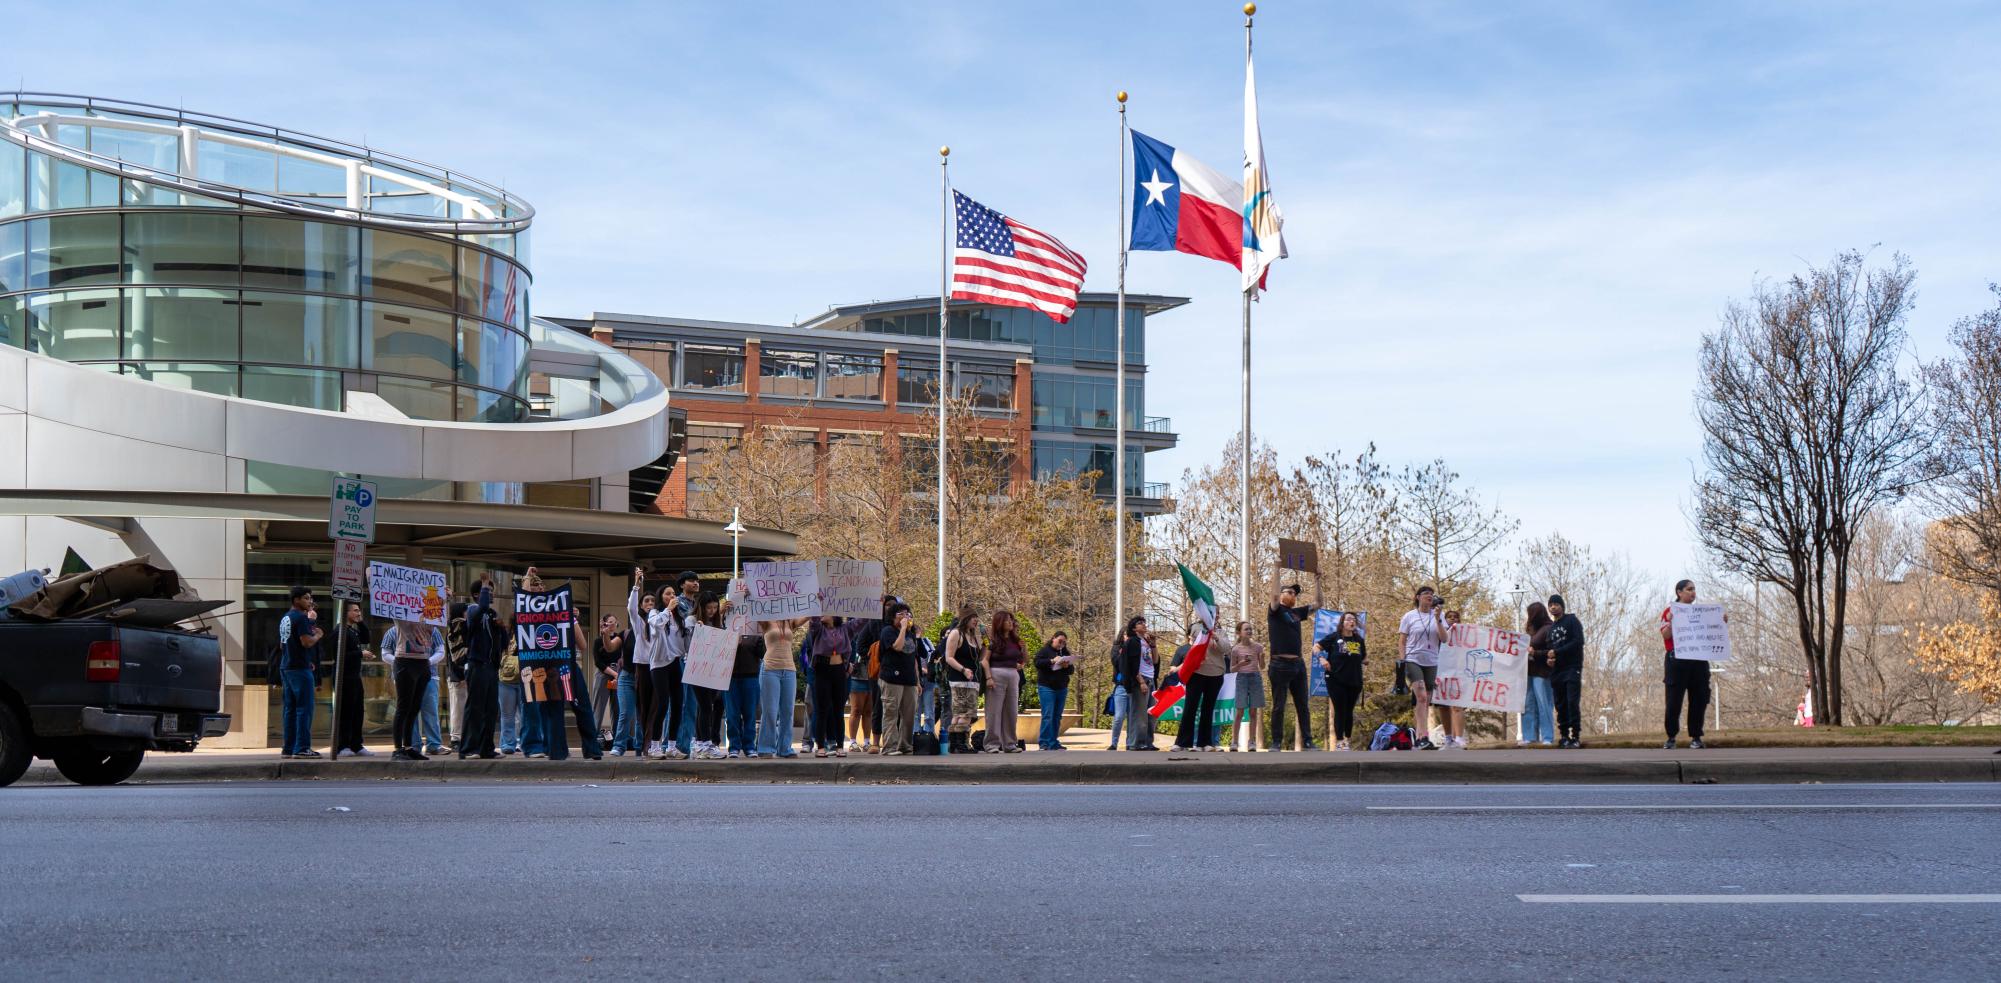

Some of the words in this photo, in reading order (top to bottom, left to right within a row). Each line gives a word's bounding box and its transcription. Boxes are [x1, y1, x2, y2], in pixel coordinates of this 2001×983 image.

[344, 505, 362, 514] PAY
[347, 513, 360, 521] TO
[339, 520, 365, 531] PARK
[345, 543, 356, 553] NO
[337, 551, 364, 561] STOPPING
[336, 566, 361, 576] STANDING
[744, 561, 813, 578] FAMILIES
[826, 560, 865, 576] FIGHT
[372, 564, 445, 588] IMMIGRANTS
[405, 583, 420, 596] THE
[756, 579, 800, 598] BELONG
[819, 586, 840, 599] NOT
[516, 590, 569, 613] FIGHT
[747, 593, 819, 616] TOGETHER
[374, 602, 409, 620] HERE!
[516, 611, 570, 623] IGNORANCE
[517, 622, 571, 650] NOT
[1448, 624, 1478, 648] NO
[1486, 627, 1520, 656] ICE
[518, 649, 571, 660] IMMIGRANTS
[1434, 677, 1462, 701] NO
[1472, 679, 1509, 707] ICE
